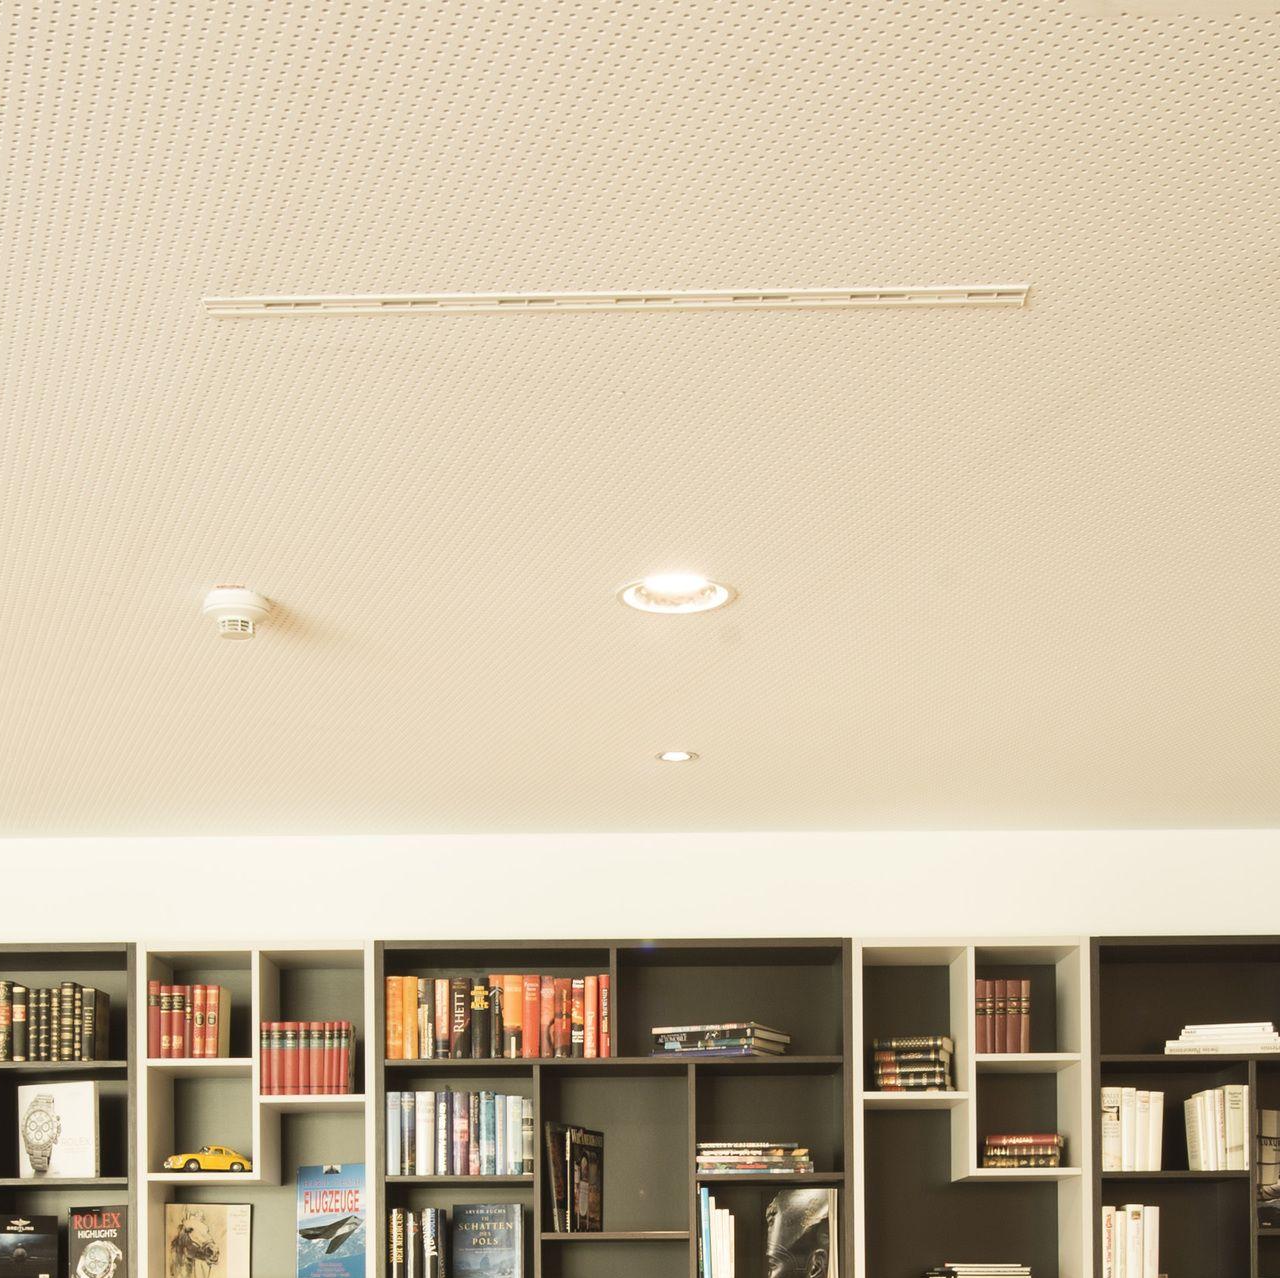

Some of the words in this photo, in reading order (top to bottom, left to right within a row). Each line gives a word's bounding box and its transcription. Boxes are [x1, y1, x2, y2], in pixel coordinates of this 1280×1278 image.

[453, 992, 465, 1033] RHETT
[304, 1189, 360, 1213] FLUGZEUGE
[73, 1212, 122, 1230] ROLEX
[458, 1222, 513, 1231] SCHATTEN
[78, 1229, 118, 1239] HIGHLIGHTS
[472, 1237, 498, 1245] POLS
